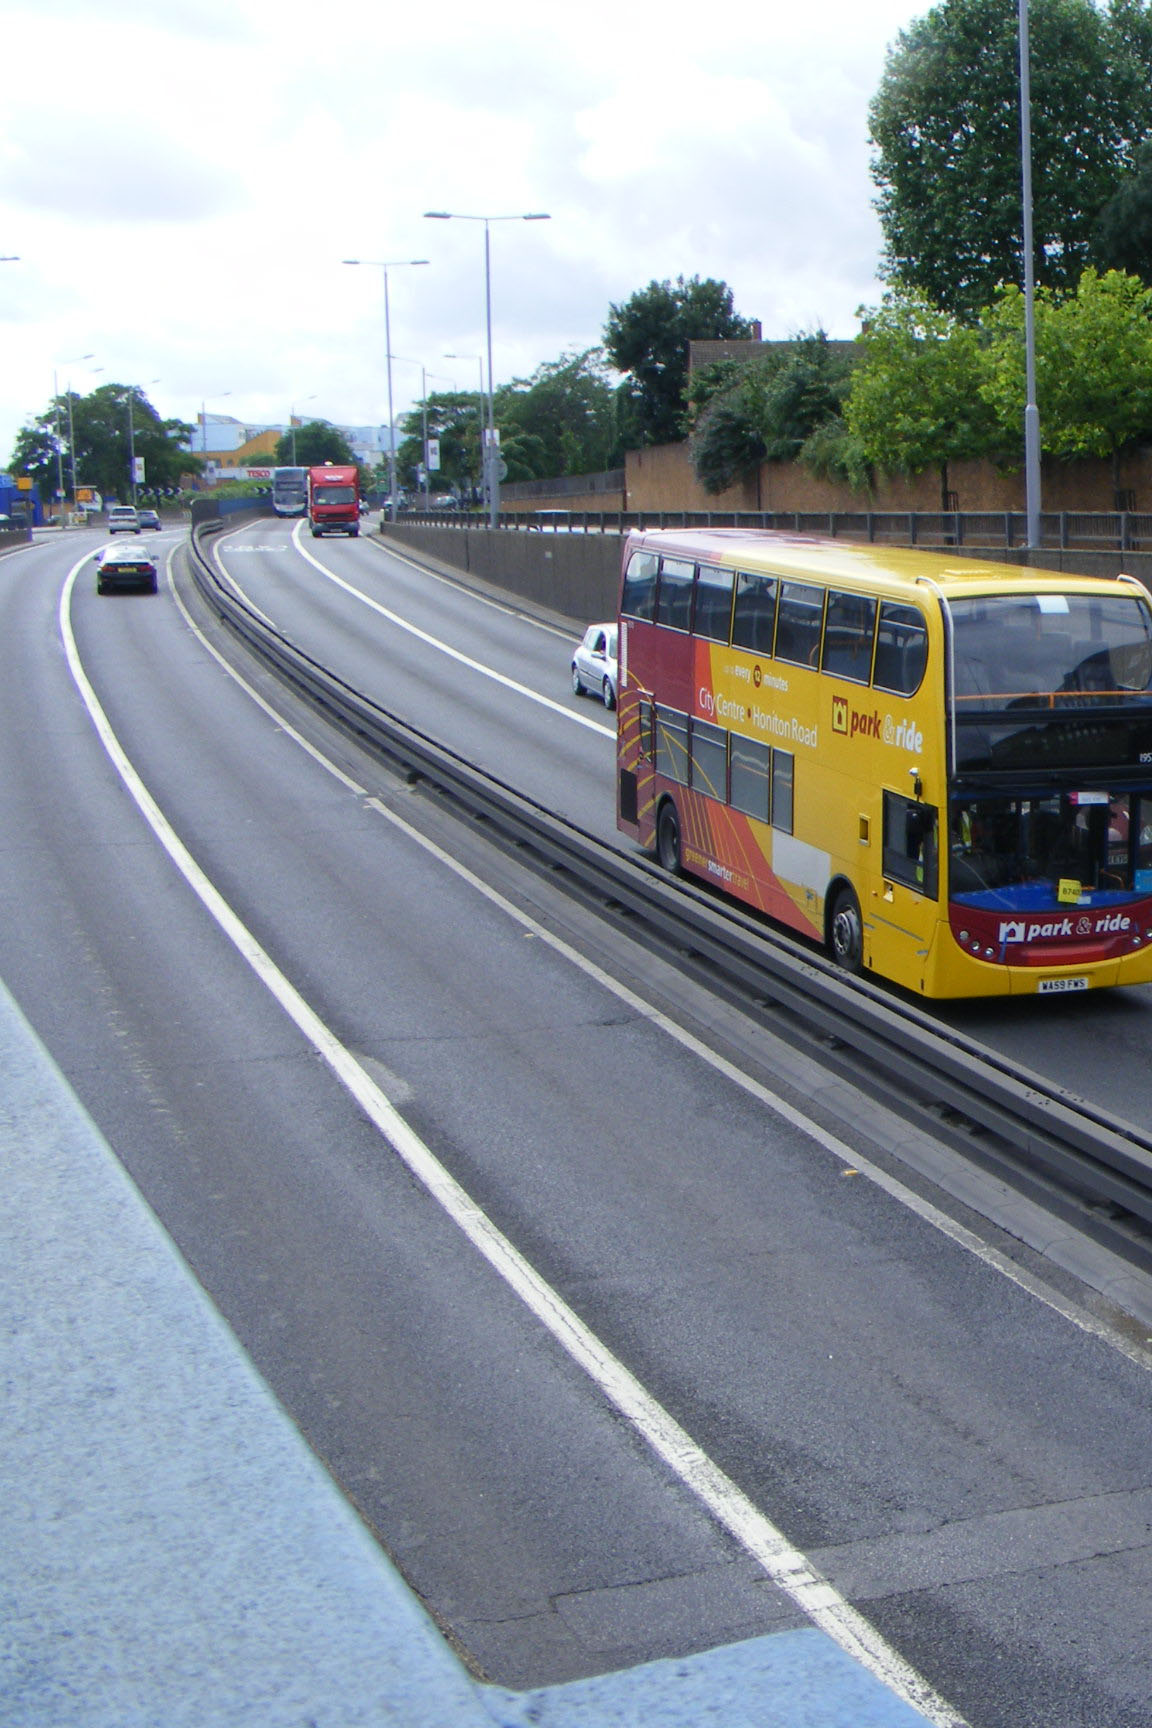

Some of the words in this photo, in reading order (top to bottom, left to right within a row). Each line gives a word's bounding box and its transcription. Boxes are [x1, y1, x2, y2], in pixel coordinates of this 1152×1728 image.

[735, 665, 751, 683] every
[763, 672, 789, 692] minutes
[699, 687, 715, 717] City
[716, 693, 745, 723] Centre
[752, 705, 790, 739] Honiton
[791, 718, 818, 748] Road
[850, 710, 881, 739] park
[883, 713, 896, 745] &
[896, 718, 924, 753] ride
[1026, 918, 1074, 942] park
[1076, 916, 1093, 935] &
[1095, 913, 1131, 933] ride
[1042, 980, 1066, 990] WA59
[1067, 978, 1085, 988] FWS
